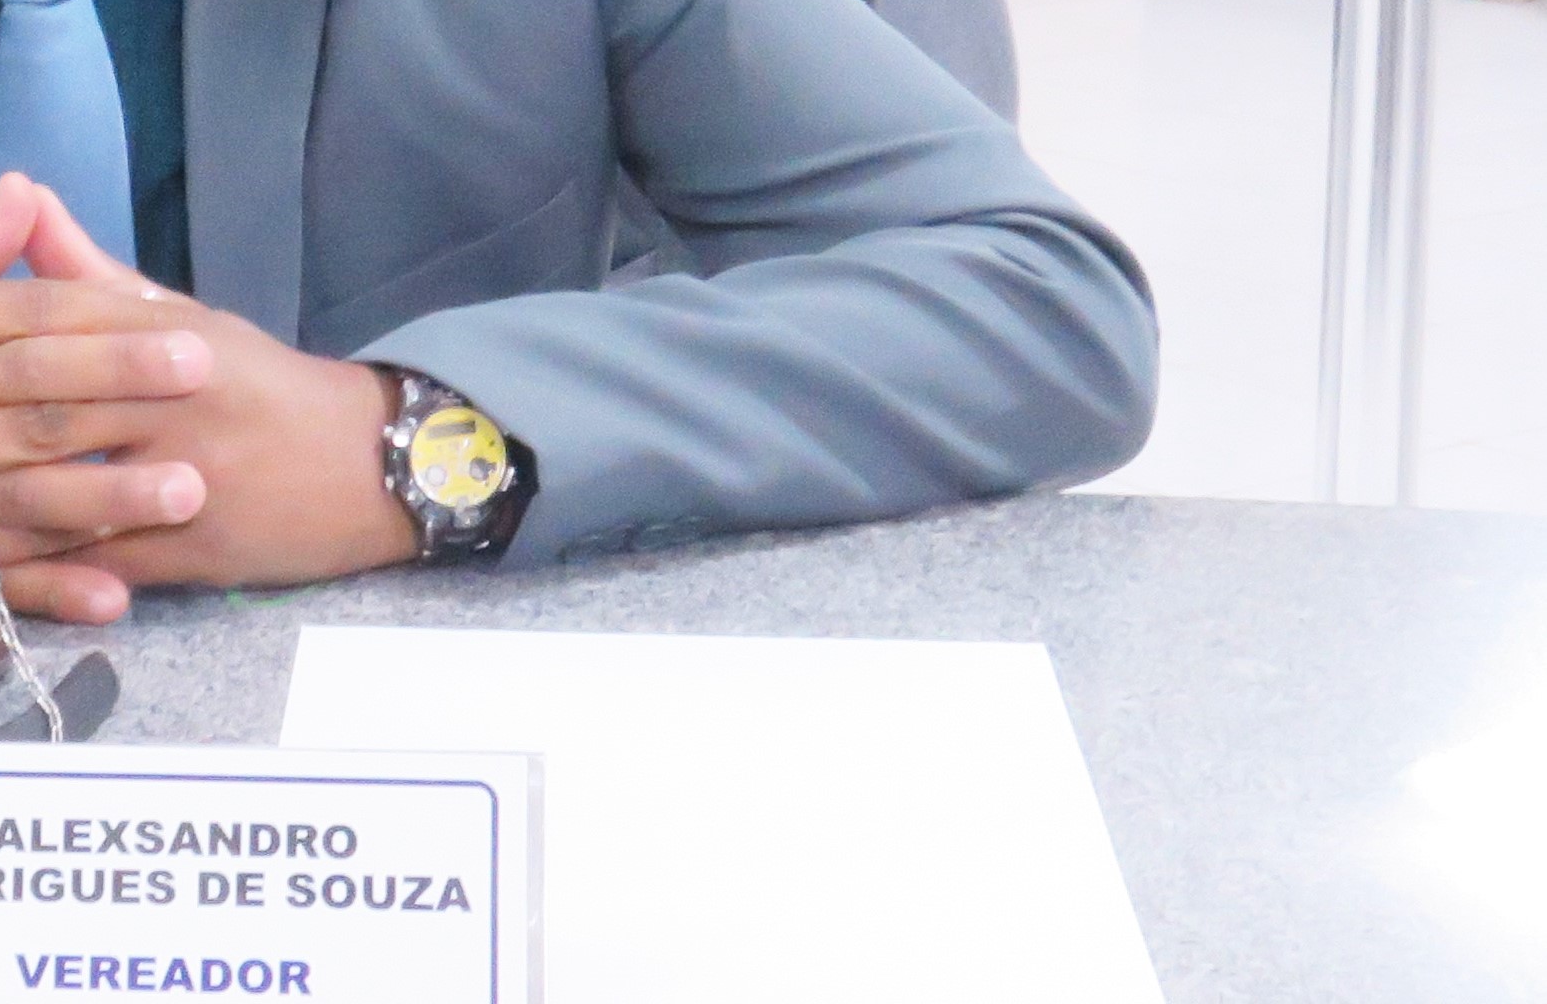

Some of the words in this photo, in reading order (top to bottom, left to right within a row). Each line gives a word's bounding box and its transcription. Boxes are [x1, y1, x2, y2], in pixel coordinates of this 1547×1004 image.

[198, 871, 265, 907] DE
[287, 873, 471, 912] SOUZA
[16, 954, 310, 995] VEREADOR
